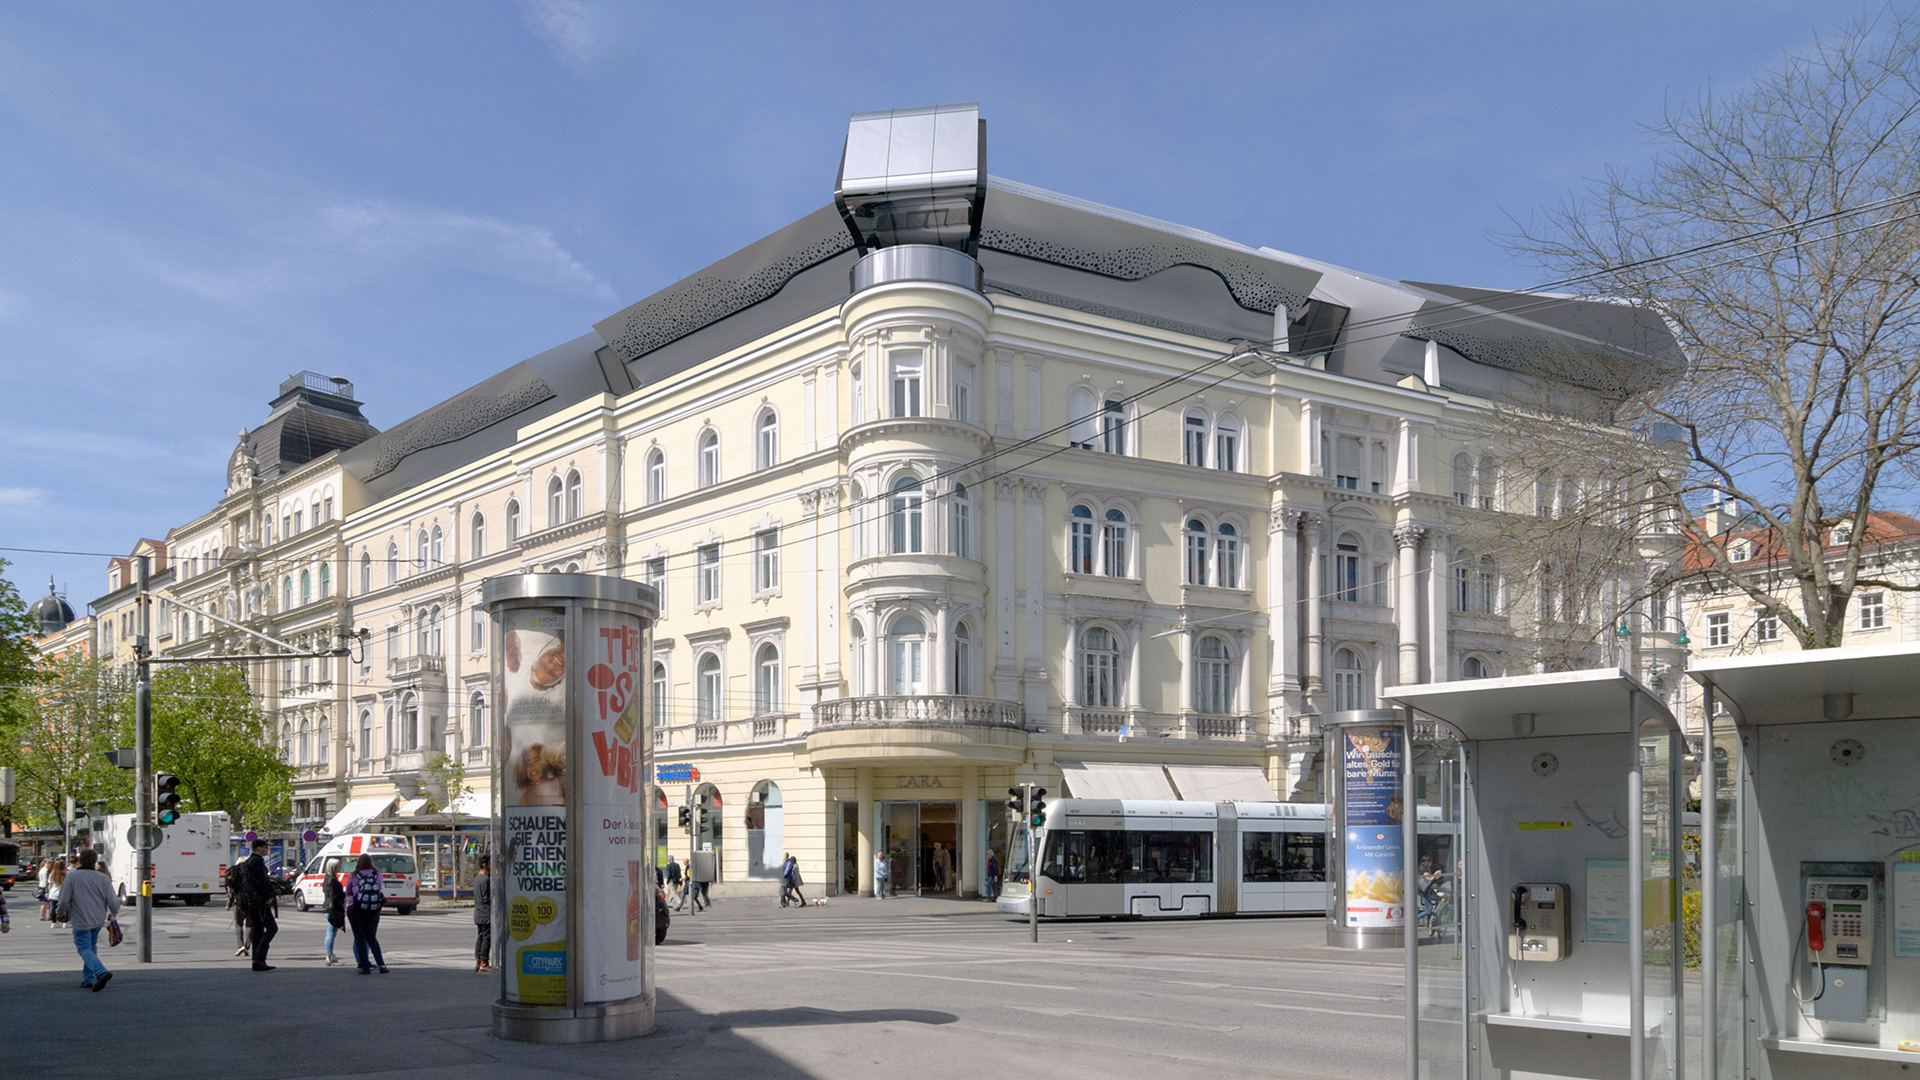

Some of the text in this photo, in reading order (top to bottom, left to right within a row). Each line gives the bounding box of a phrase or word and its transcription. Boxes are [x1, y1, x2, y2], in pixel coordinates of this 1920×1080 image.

[1346, 751, 1364, 760] Wir
[1346, 760, 1369, 769] altes
[1370, 760, 1390, 768] Gold
[1346, 770, 1367, 778] bare
[896, 775, 942, 789] ZARA
[509, 816, 566, 831] SCHAUEN
[603, 818, 622, 830] Der
[515, 831, 566, 846] SIE AUF
[608, 836, 626, 845] von
[523, 847, 566, 861] EINEN
[513, 862, 566, 876] SPRUNG
[512, 904, 529, 914] 2000
[536, 905, 552, 916] 100
[531, 956, 563, 967] CITYPARK
